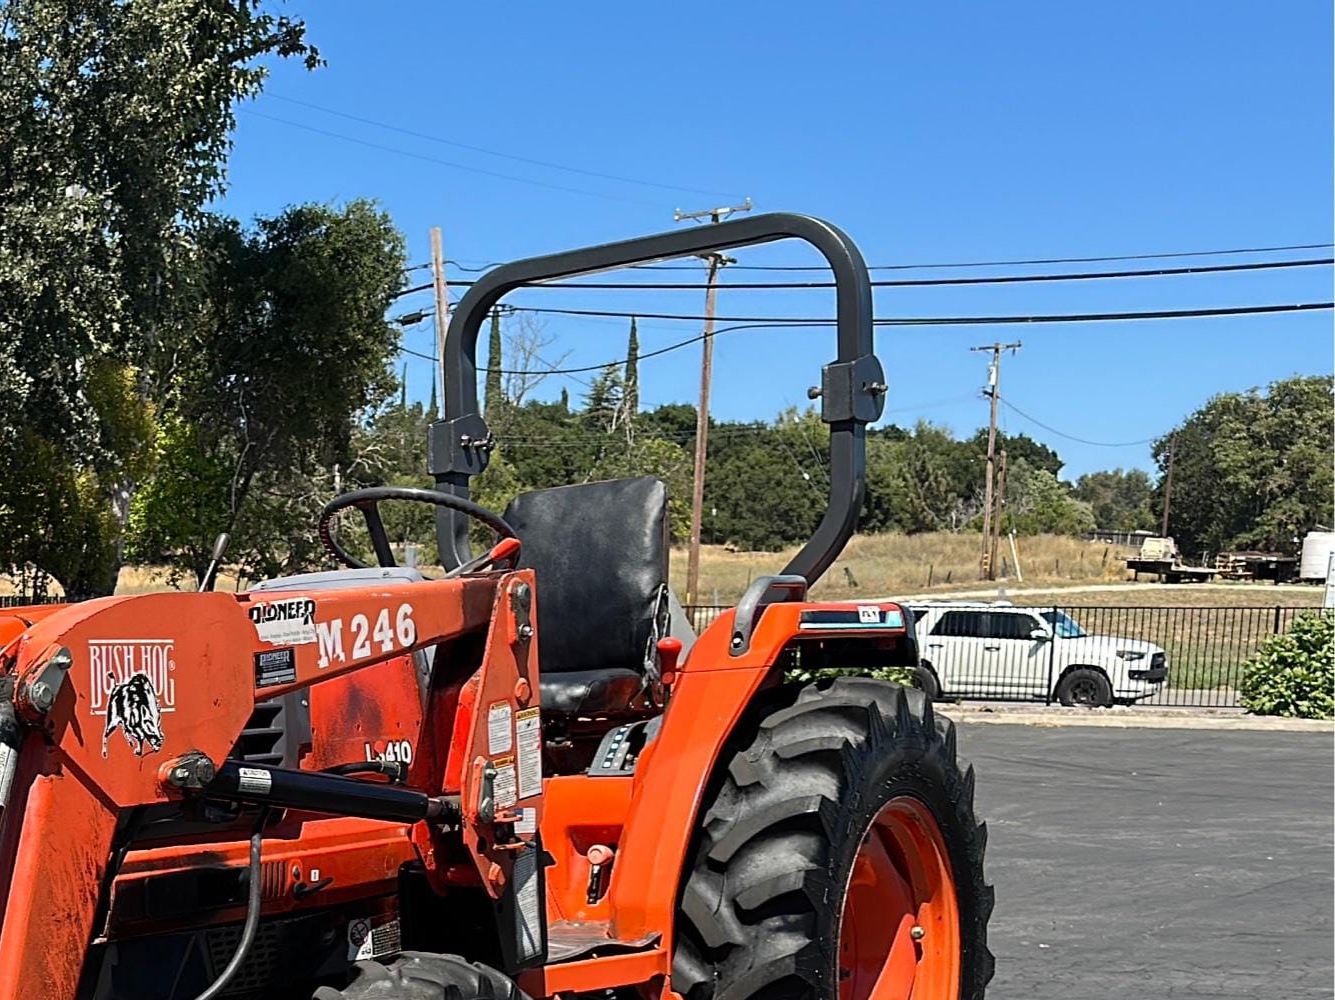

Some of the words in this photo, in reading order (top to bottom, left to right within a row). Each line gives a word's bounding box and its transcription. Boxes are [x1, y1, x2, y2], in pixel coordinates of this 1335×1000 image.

[317, 619, 346, 668] M
[351, 603, 415, 660] 246
[89, 645, 135, 708] BUSH
